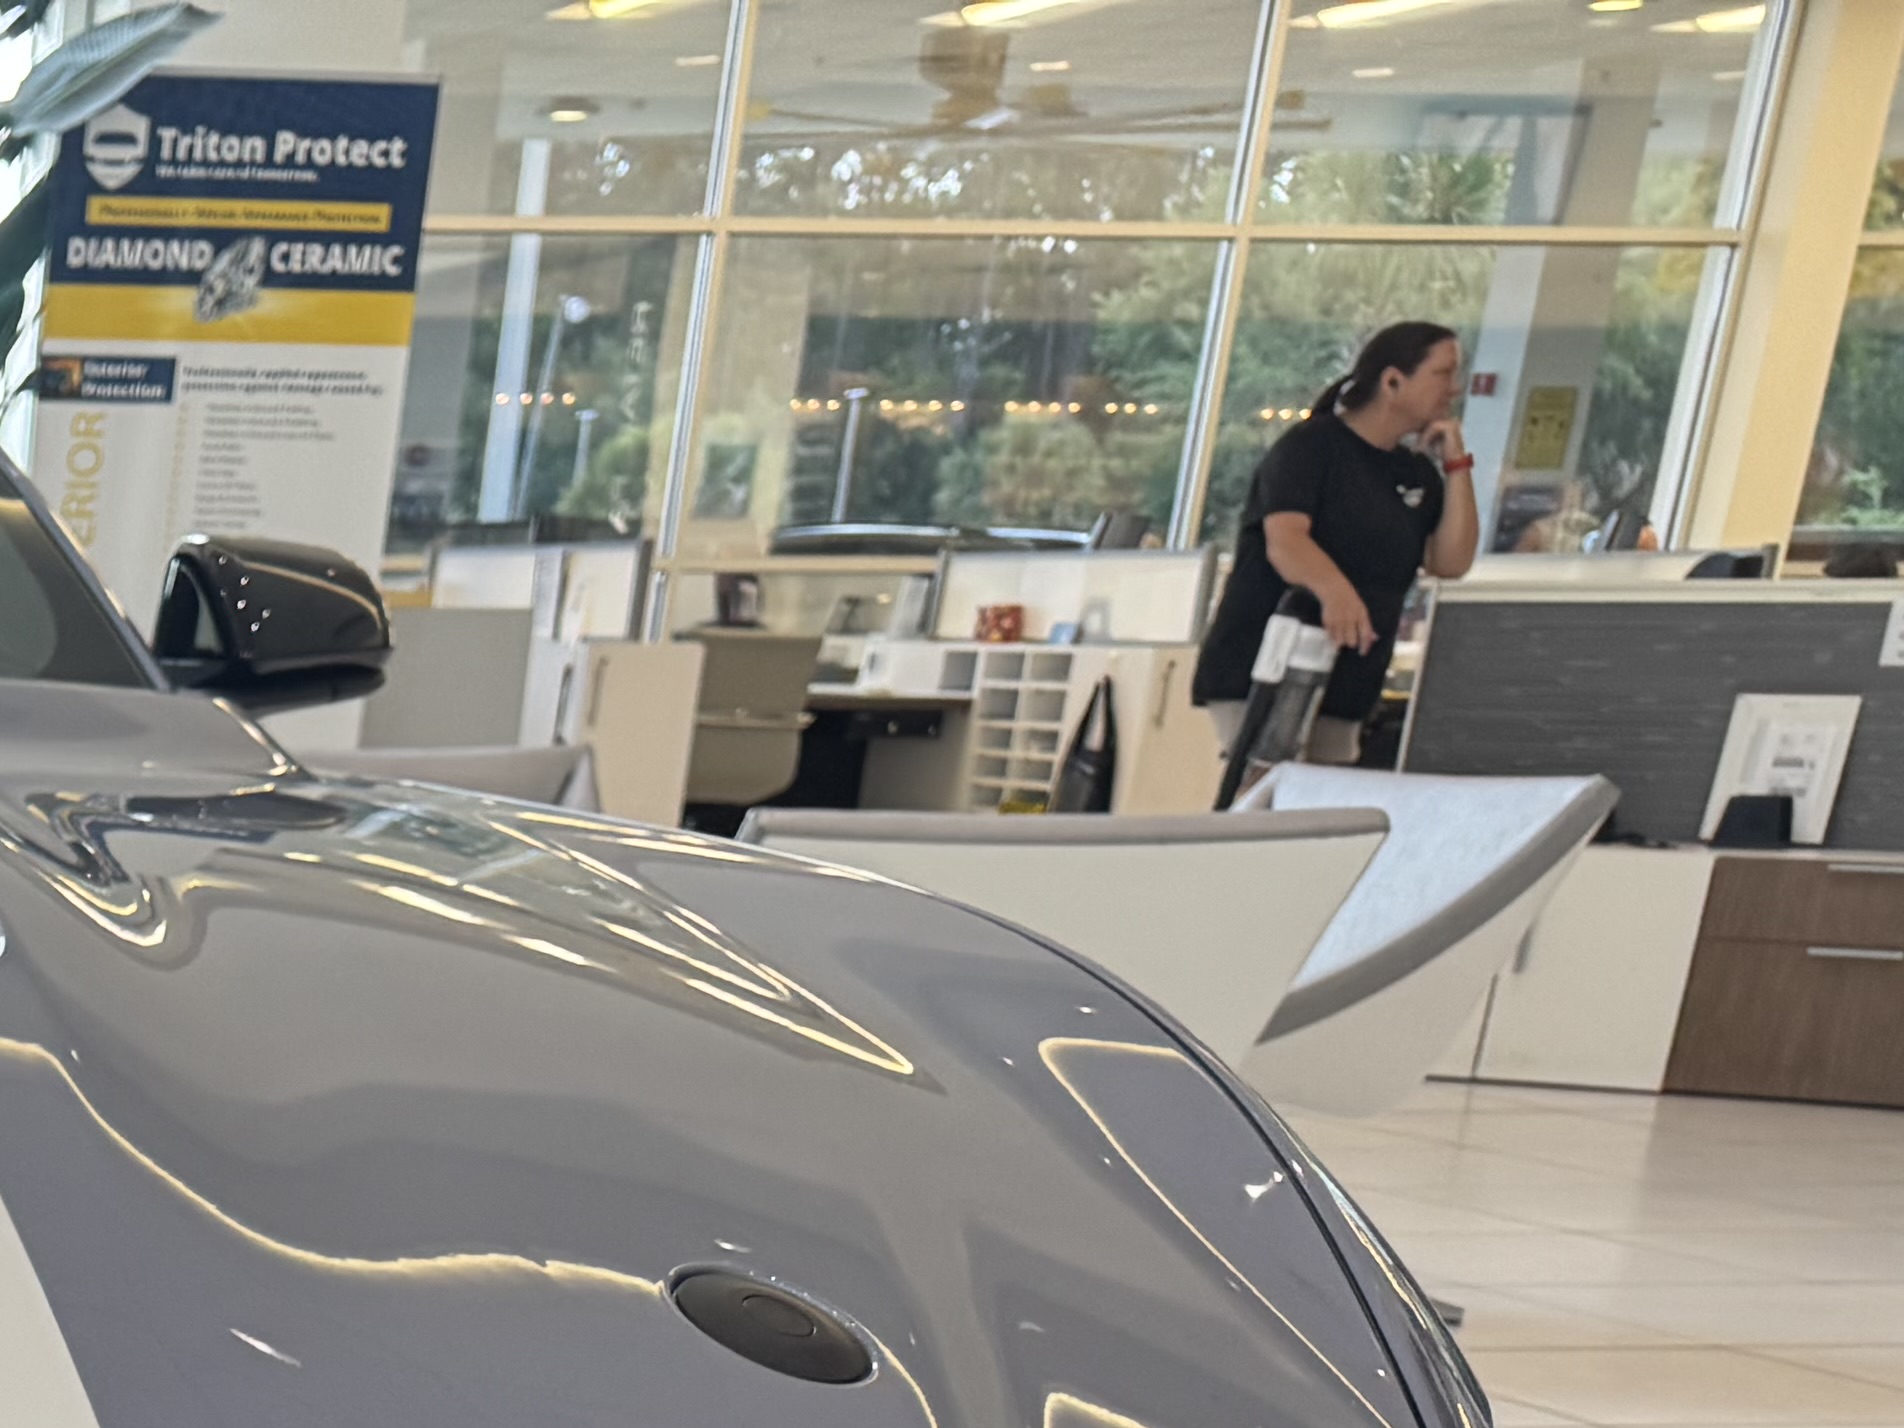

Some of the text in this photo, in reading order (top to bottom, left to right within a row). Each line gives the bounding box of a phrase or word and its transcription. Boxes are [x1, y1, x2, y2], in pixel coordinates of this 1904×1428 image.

[156, 124, 408, 169] Triton Protect
[65, 236, 406, 277] DIAMOND CERAMIC
